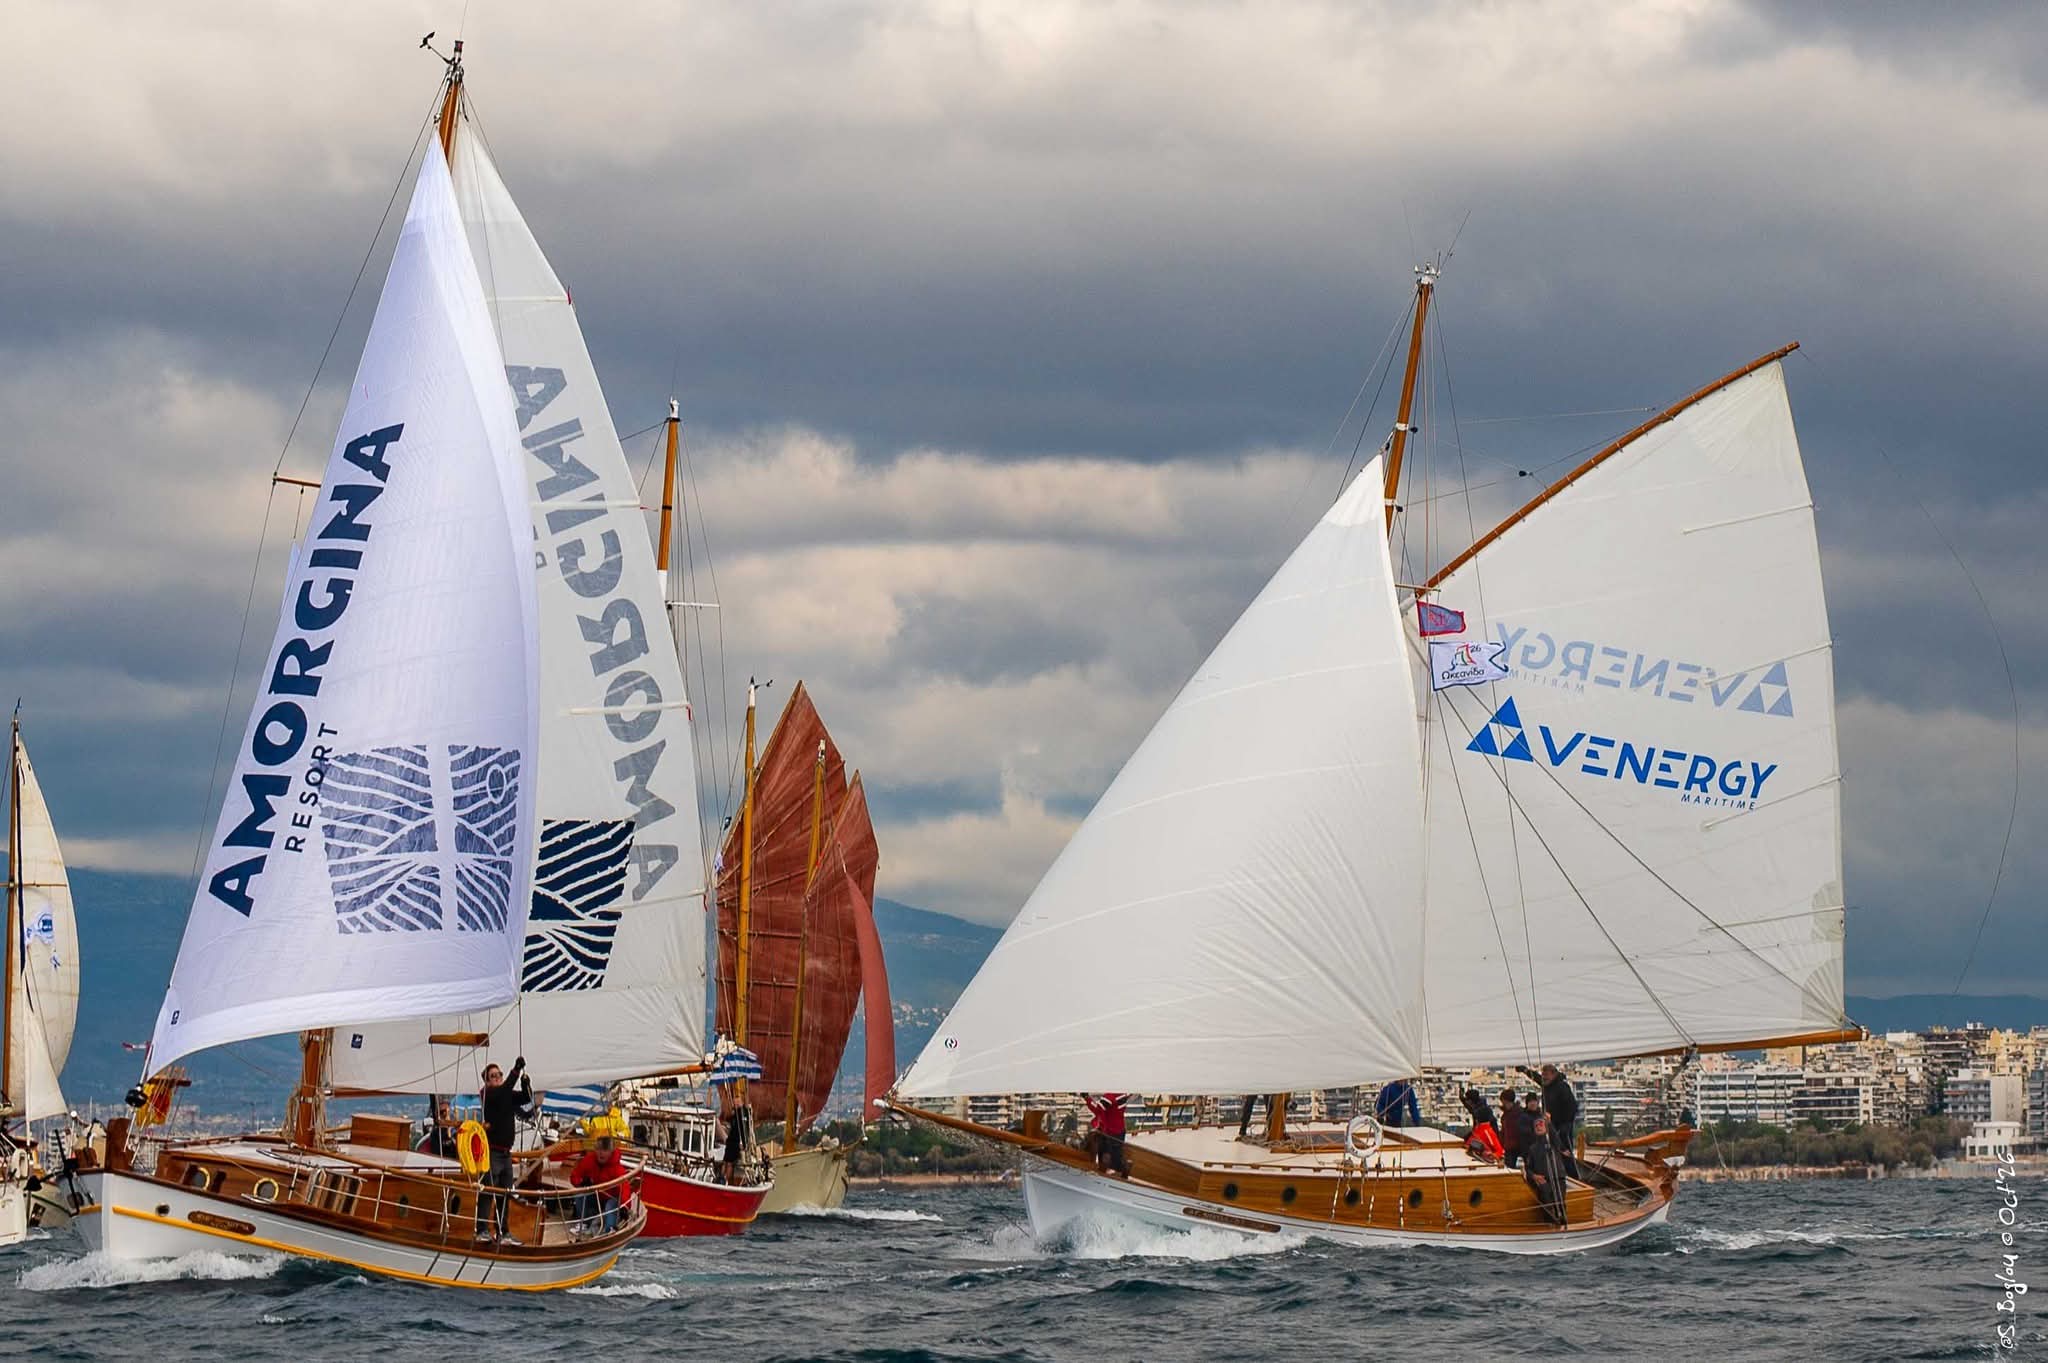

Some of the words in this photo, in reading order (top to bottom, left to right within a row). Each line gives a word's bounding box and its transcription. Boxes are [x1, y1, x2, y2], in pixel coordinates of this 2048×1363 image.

[208, 423, 405, 917] AMORGINA
[284, 722, 339, 853] RESORT
[1539, 725, 1777, 799] VENERGY
[1681, 794, 1756, 810] MARITIME
